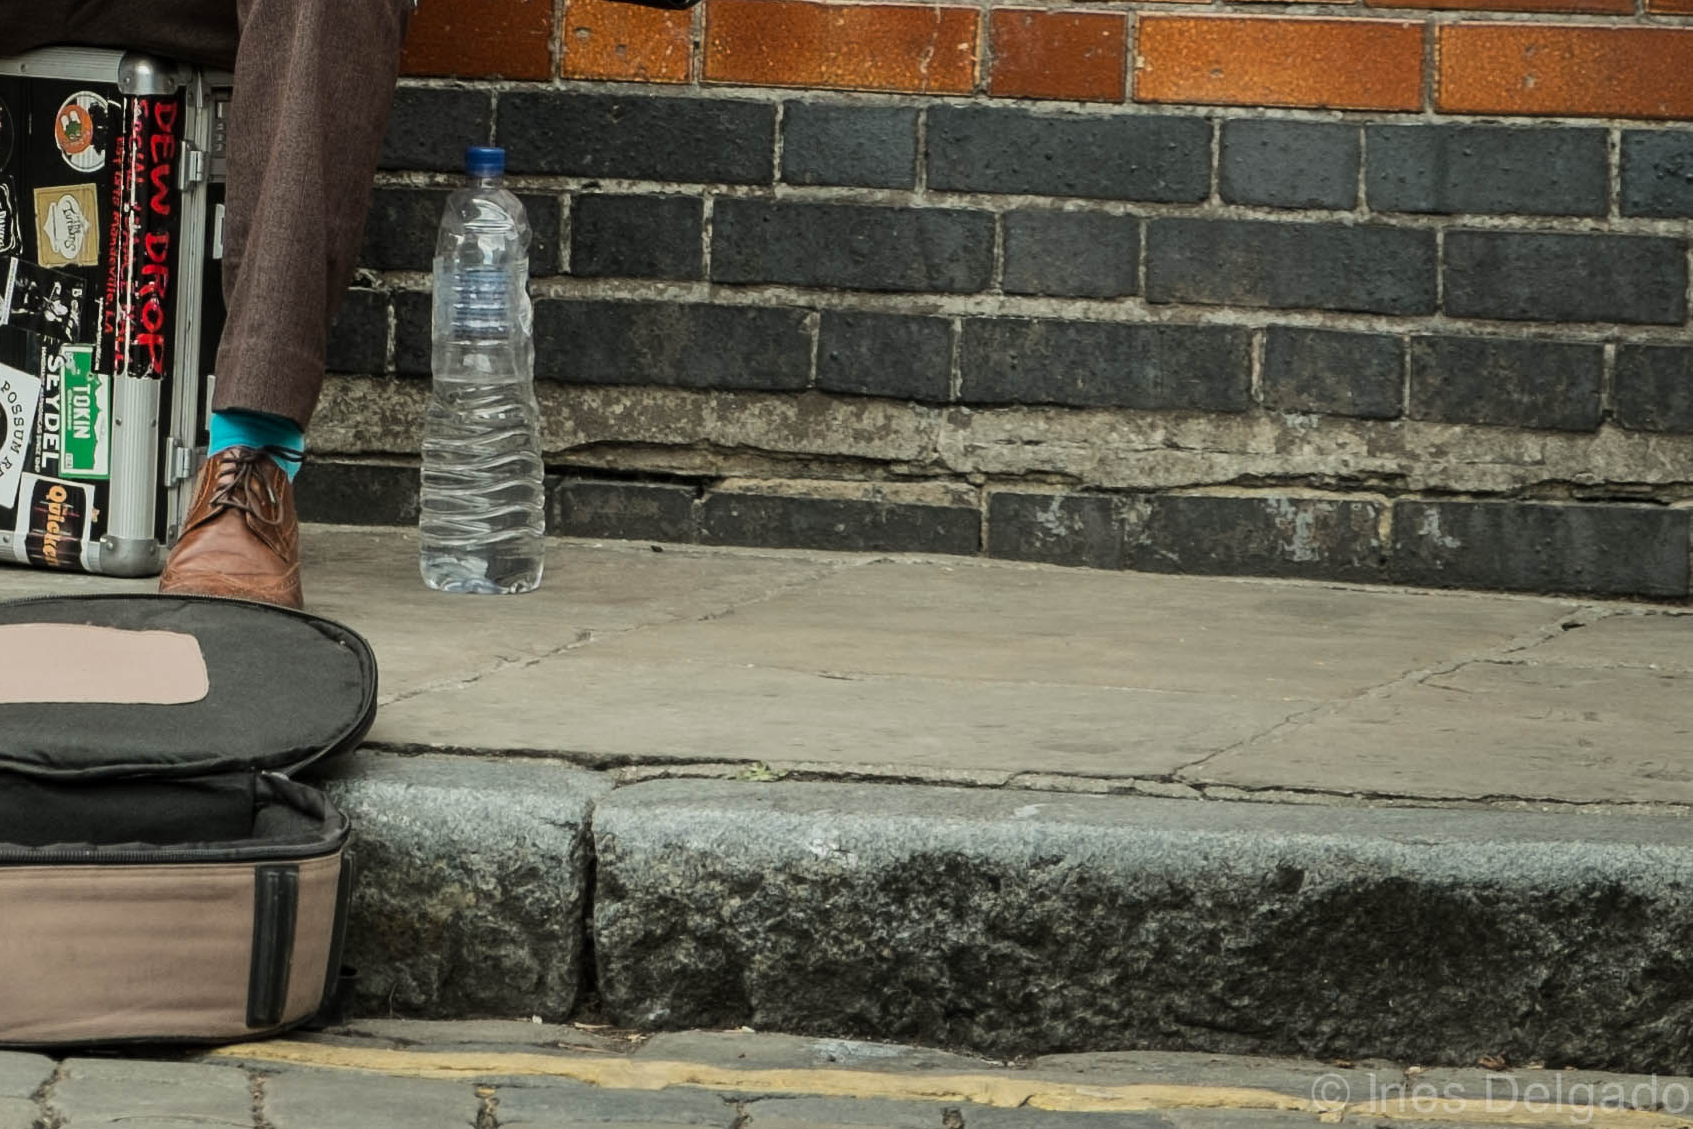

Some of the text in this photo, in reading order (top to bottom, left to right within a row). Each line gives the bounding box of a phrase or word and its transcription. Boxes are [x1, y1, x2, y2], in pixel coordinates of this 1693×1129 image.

[137, 102, 178, 375] DEW DROP
[105, 311, 115, 334] LA
[0, 381, 25, 454] POSSUM
[42, 355, 65, 468] SEYDEL
[73, 384, 91, 439] TOKIN
